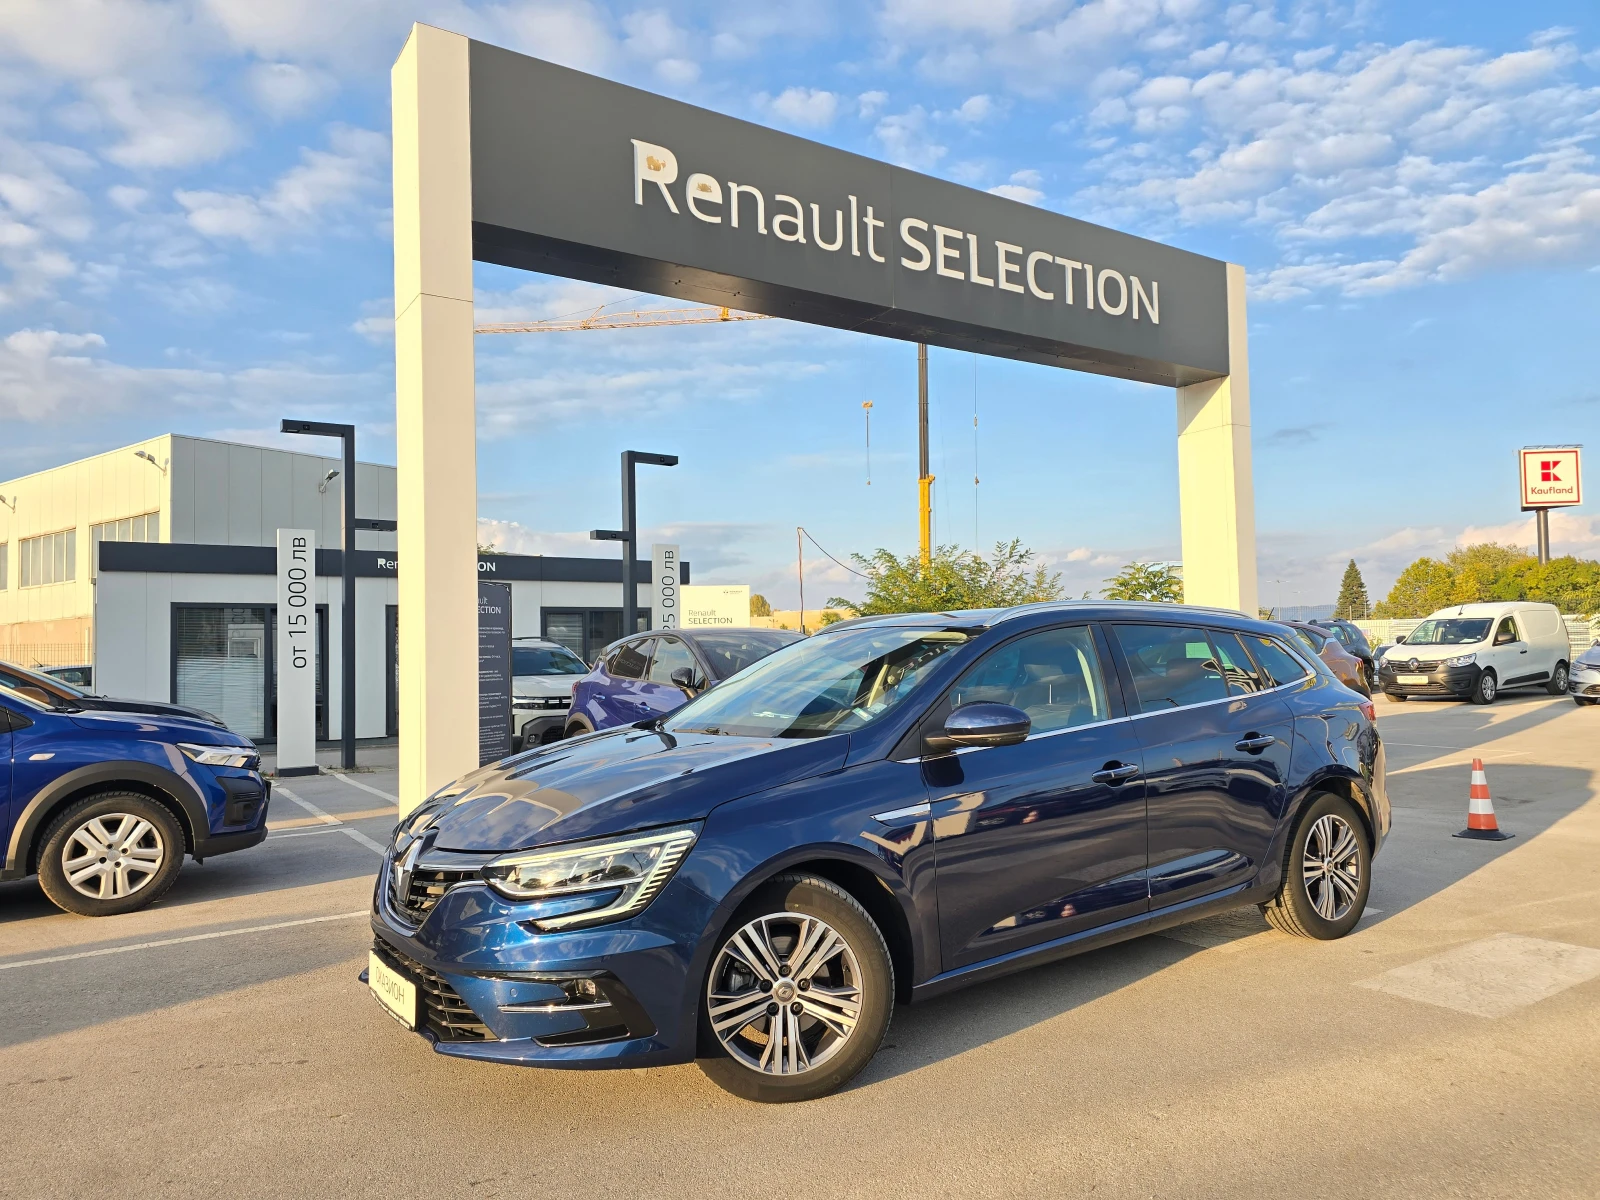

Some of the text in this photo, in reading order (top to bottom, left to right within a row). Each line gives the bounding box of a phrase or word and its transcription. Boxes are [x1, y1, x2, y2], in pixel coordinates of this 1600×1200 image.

[630, 138, 1160, 325] Renault SELECTION
[1530, 486, 1574, 495] Kaufland
[664, 550, 675, 571] лв
[661, 575, 675, 608] 000
[288, 537, 307, 669] от 15 000 лв
[688, 609, 717, 617] Renault
[688, 617, 733, 625] SELECTION
